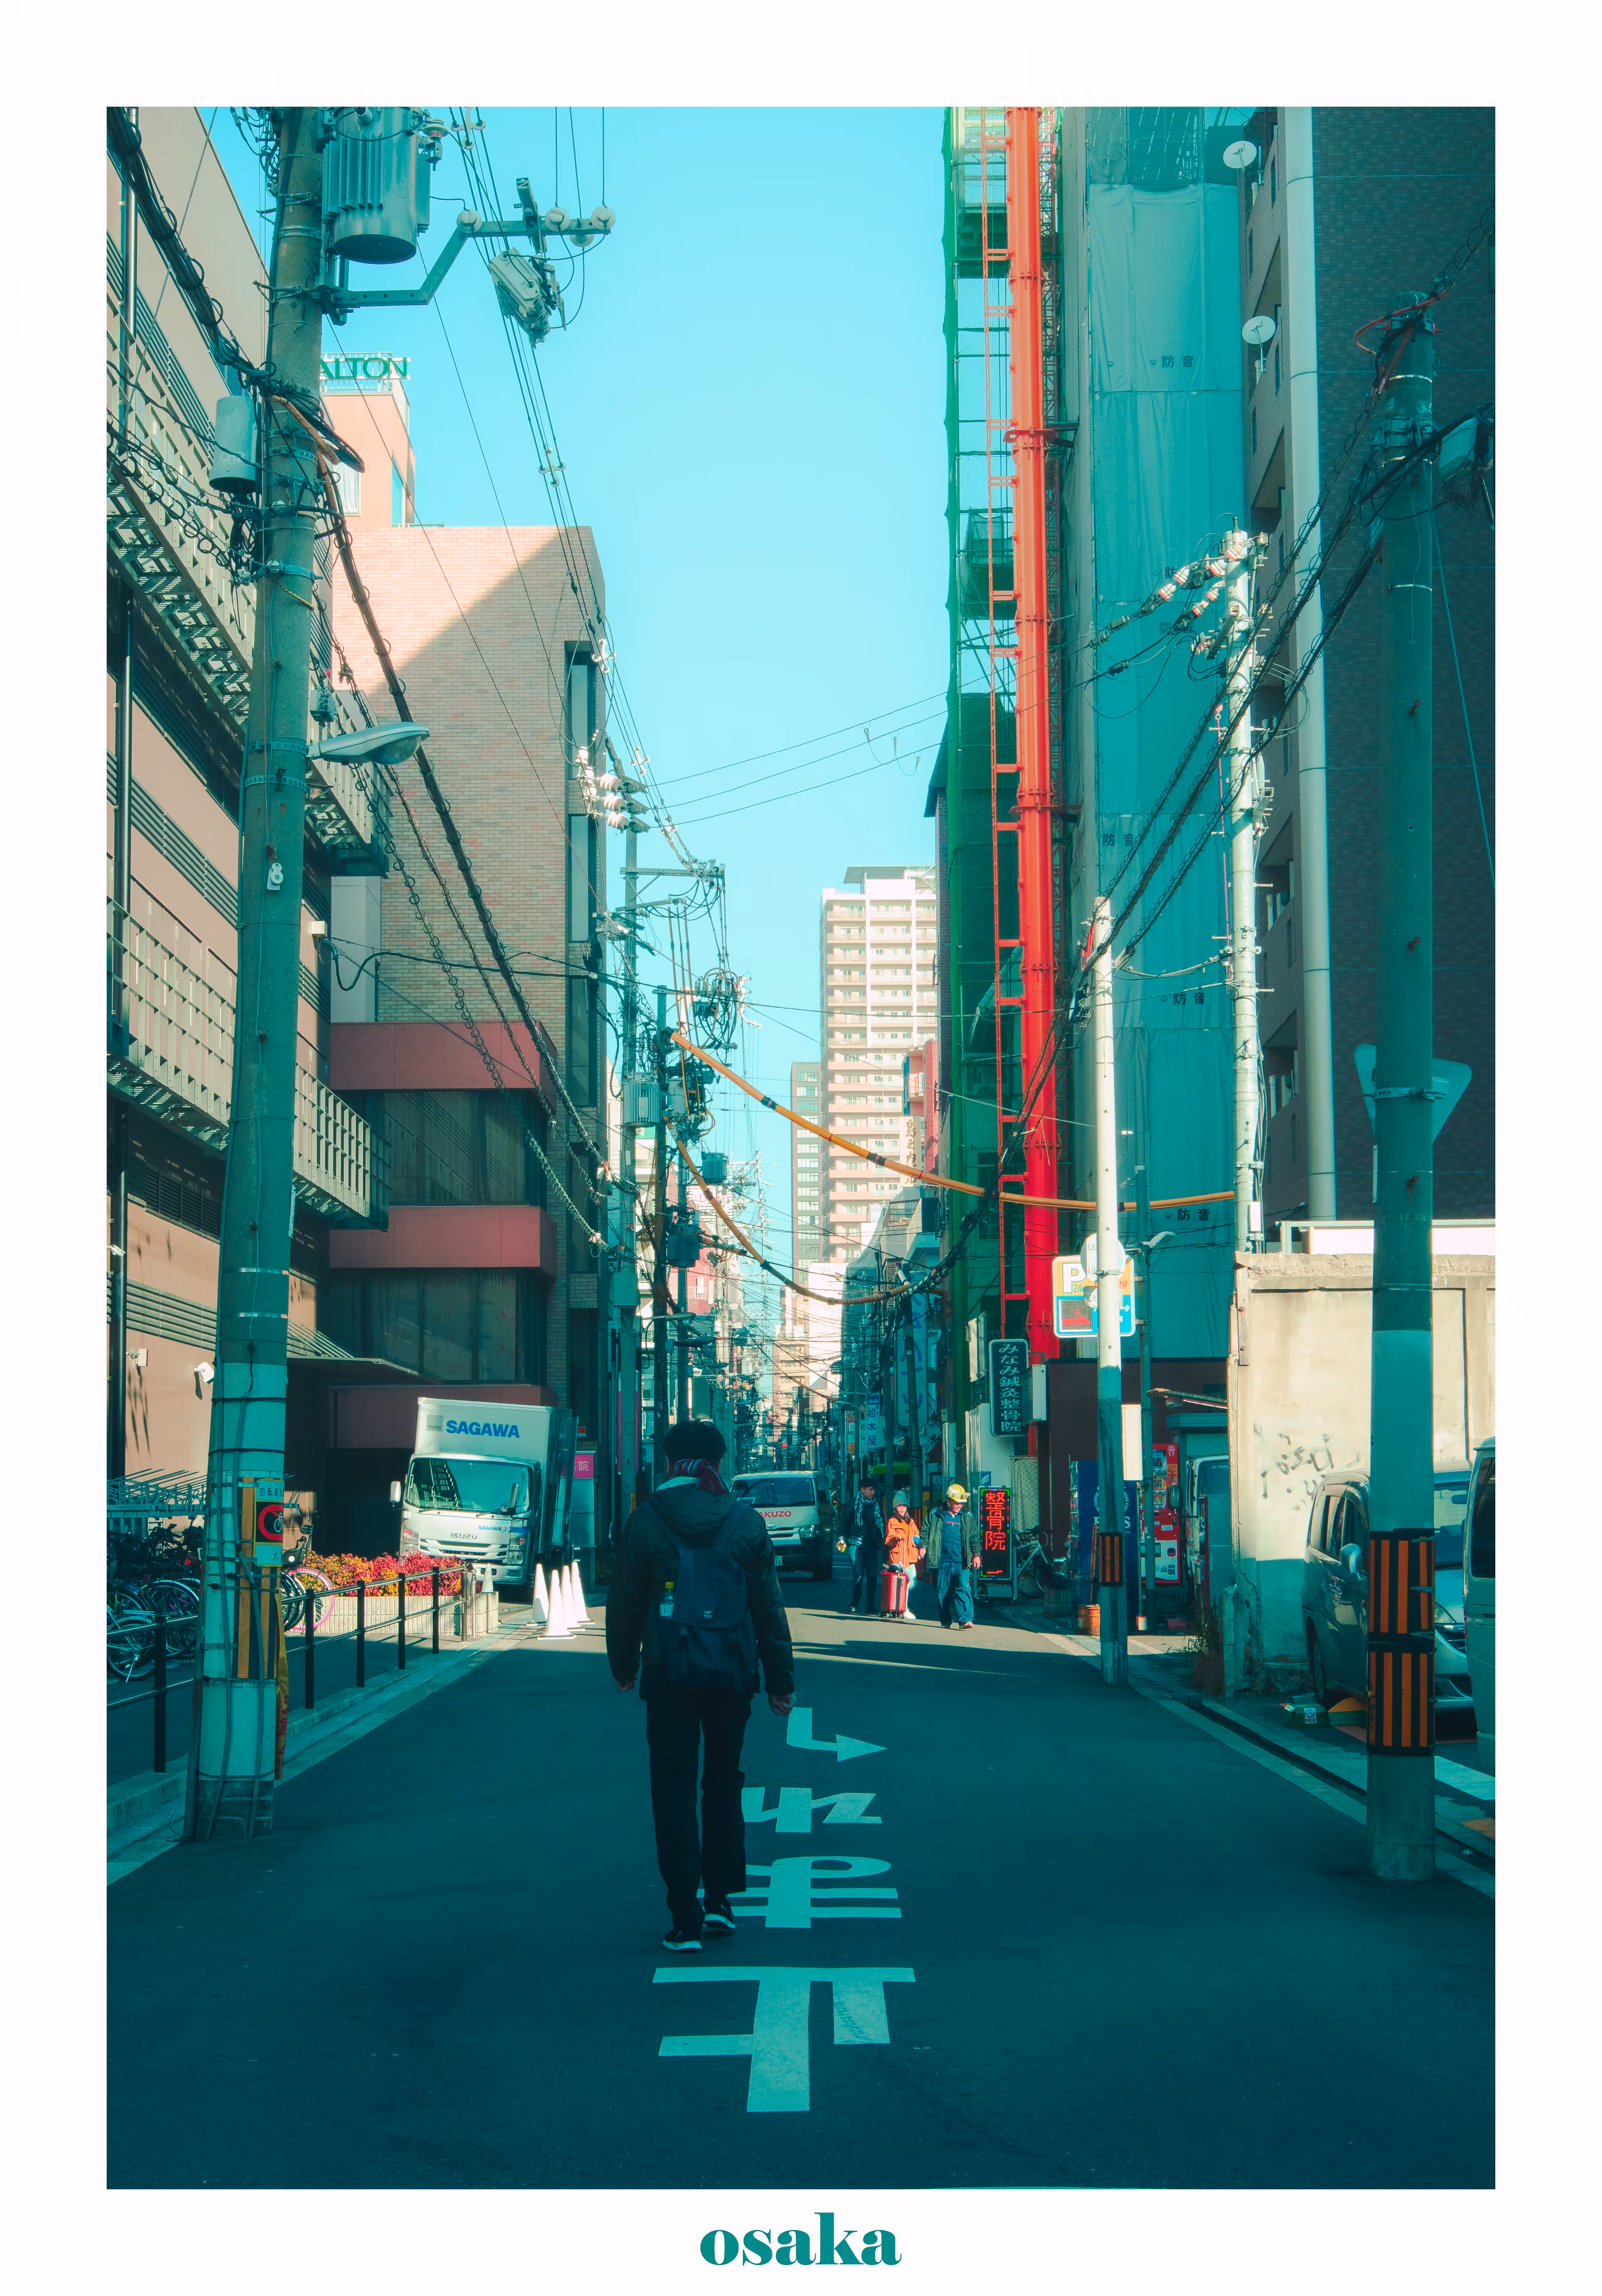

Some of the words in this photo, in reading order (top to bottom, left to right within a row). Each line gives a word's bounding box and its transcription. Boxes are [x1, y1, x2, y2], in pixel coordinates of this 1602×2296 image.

[1162, 355, 1193, 368] 防音
[1173, 992, 1205, 1005] 防音
[1177, 1208, 1209, 1221] 防音
[1062, 1263, 1087, 1294] P
[999, 1344, 1021, 1432] みなみ鍼灸整骨院
[446, 1420, 520, 1438] SAGAWA
[867, 1408, 878, 1446] 松本屋
[575, 1461, 588, 1471] 院
[985, 1492, 1005, 1550] 整骨院
